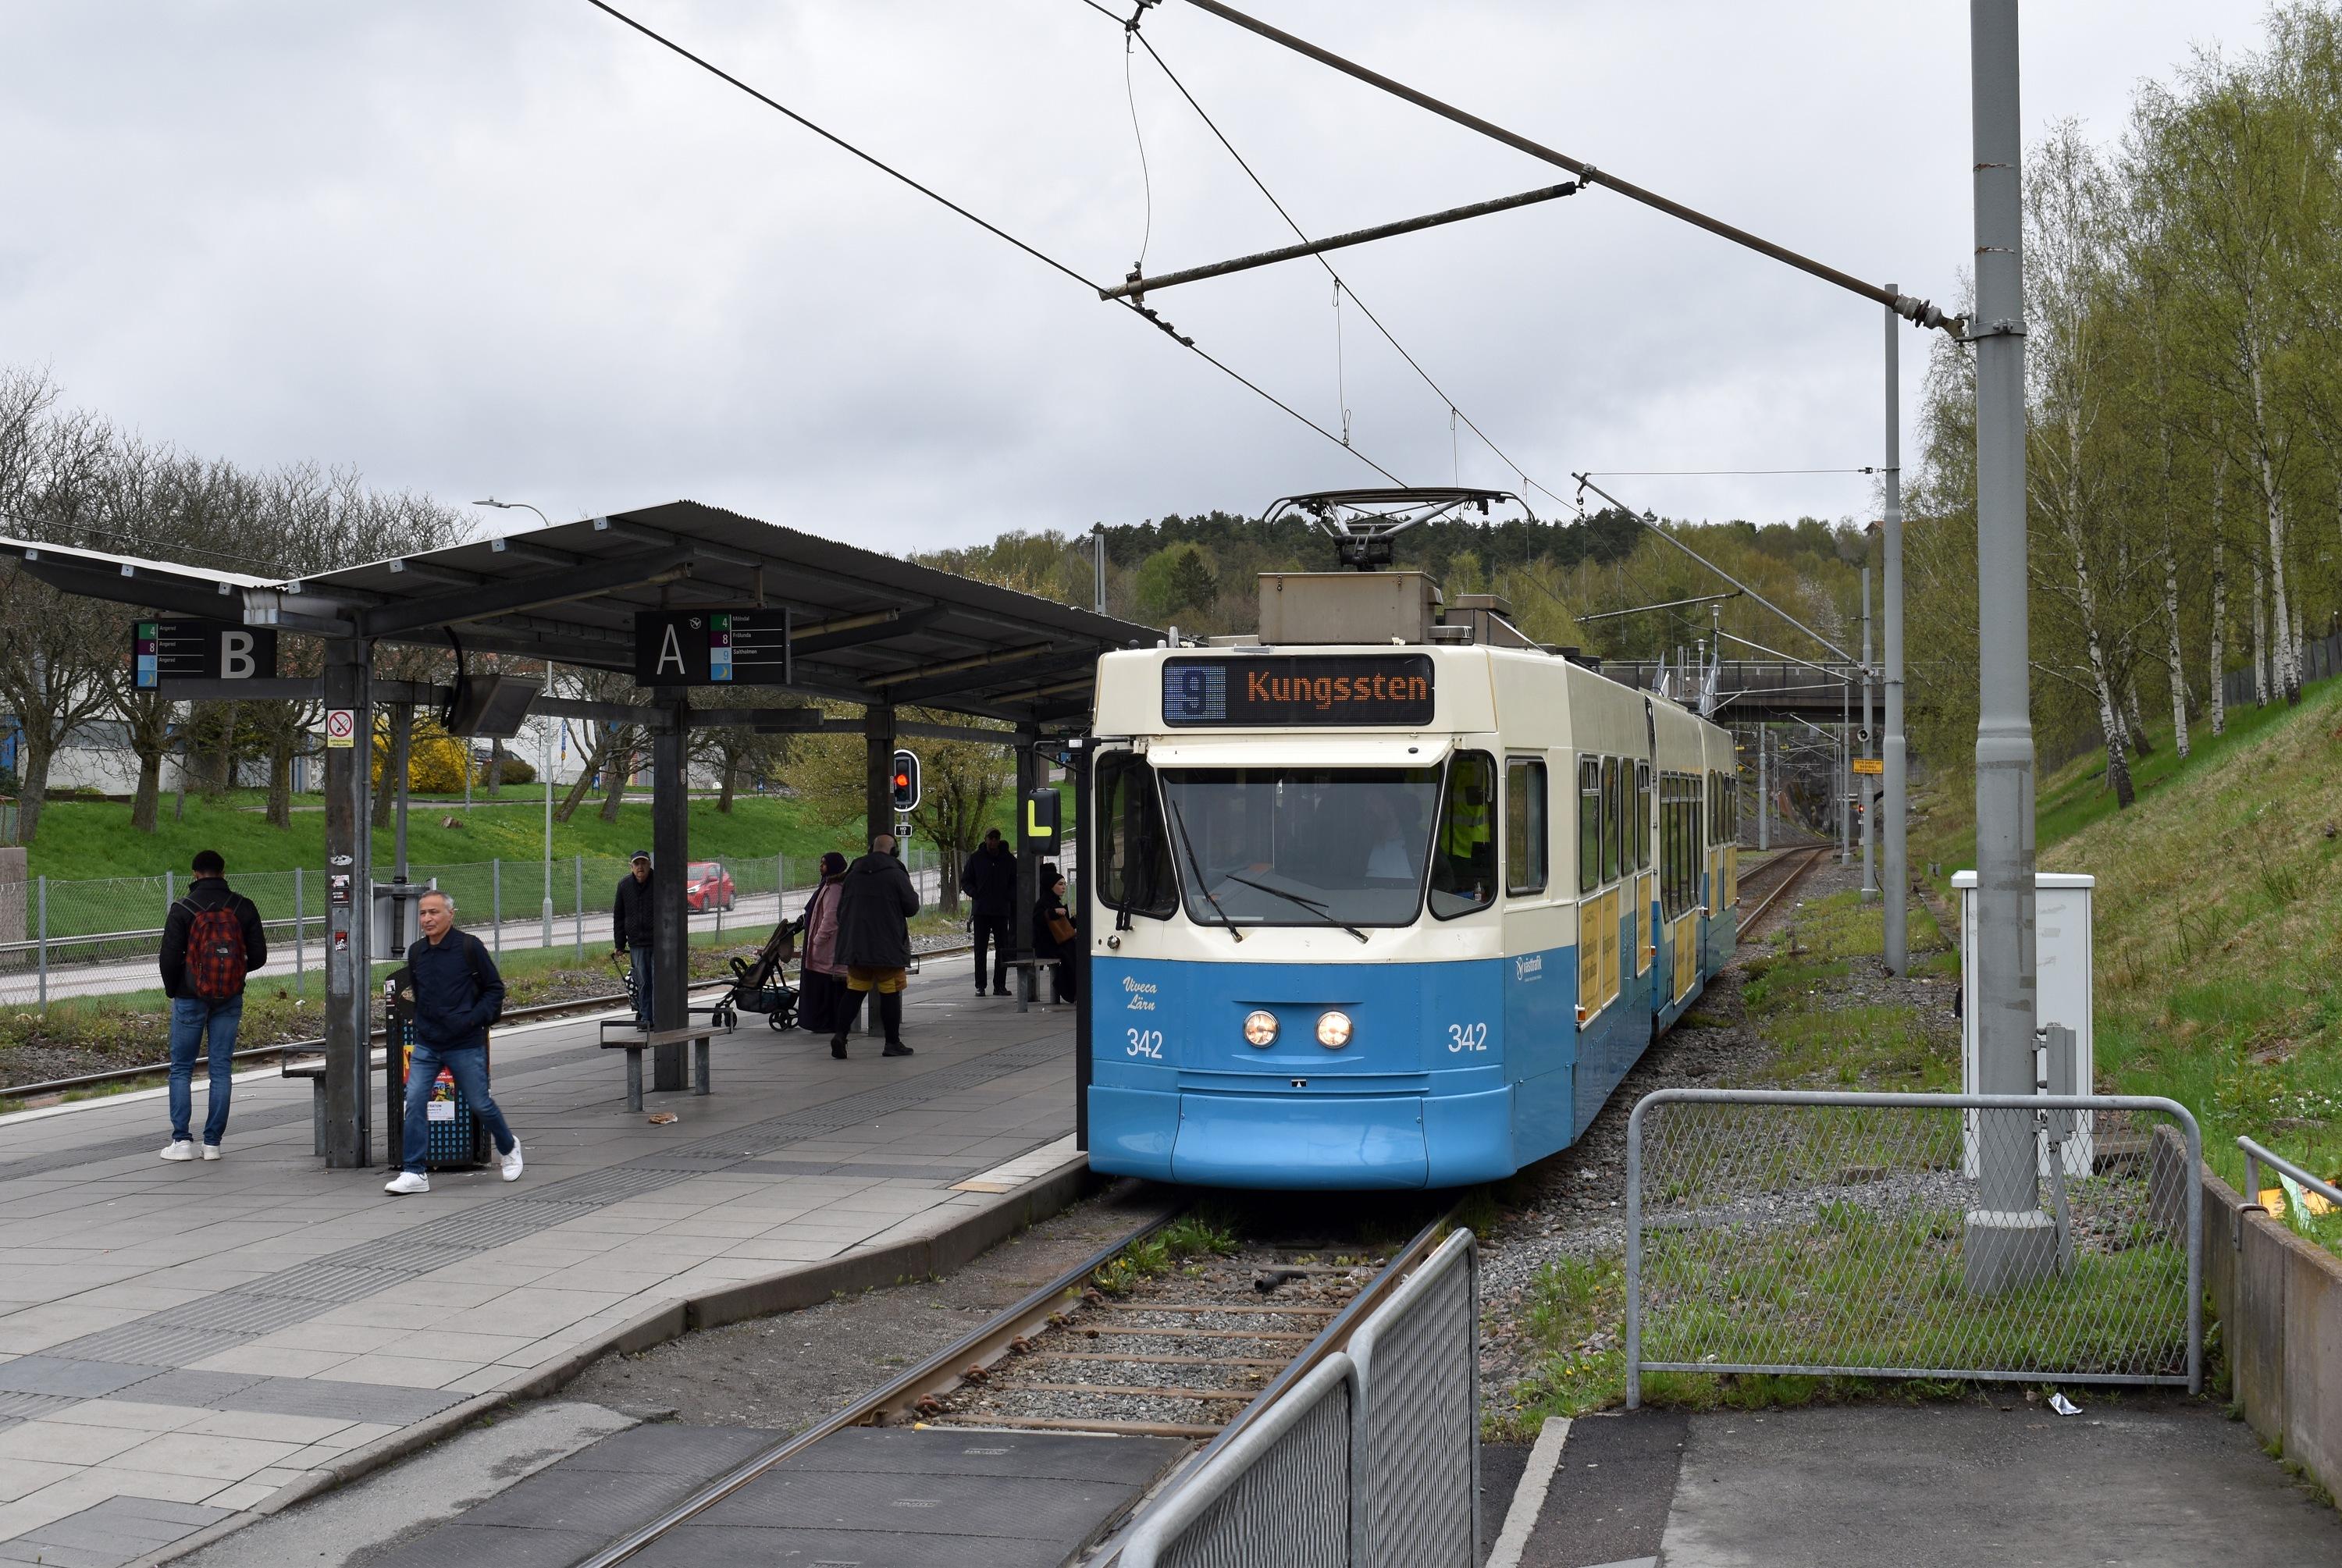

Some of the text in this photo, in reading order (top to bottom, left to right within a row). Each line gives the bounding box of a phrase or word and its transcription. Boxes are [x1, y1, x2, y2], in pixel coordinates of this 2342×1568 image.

[150, 626, 155, 636] 4
[722, 617, 728, 628] 4
[149, 642, 155, 652] 8
[722, 634, 728, 644] 8
[221, 631, 255, 679] B
[657, 624, 685, 674] A
[723, 650, 729, 660] 9
[149, 658, 155, 667] 9
[1182, 669, 1427, 715] 9 Kungssten
[1123, 976, 1158, 994] Viveca
[1127, 994, 1155, 1011] Lärn
[1127, 1028, 1162, 1059] 342
[1448, 1022, 1487, 1053] 342
